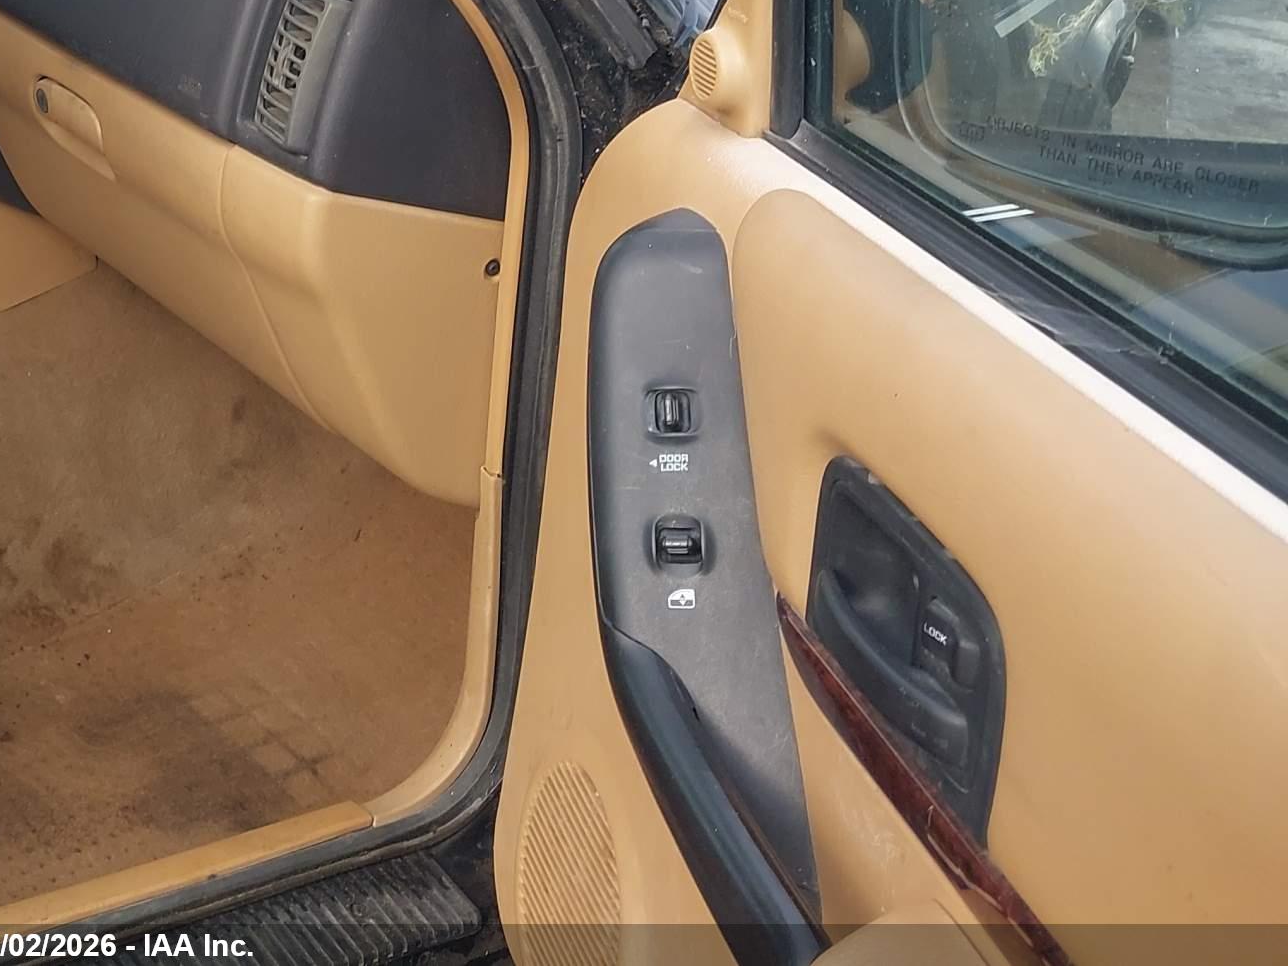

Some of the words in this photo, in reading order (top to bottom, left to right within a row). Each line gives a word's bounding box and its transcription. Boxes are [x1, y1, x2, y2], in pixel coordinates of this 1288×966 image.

[986, 115, 1050, 141] OBJECTS
[1062, 134, 1077, 149] IN
[1085, 139, 1144, 165] MIRROR
[1153, 156, 1184, 173] ARE
[1194, 166, 1260, 193] CLOSER
[1039, 145, 1077, 165] THAN
[1087, 157, 1125, 178] THEY
[1132, 169, 1194, 194] APPEAR
[659, 454, 688, 463] DOOR
[661, 463, 689, 471] LOCK
[923, 621, 948, 646] LOCK
